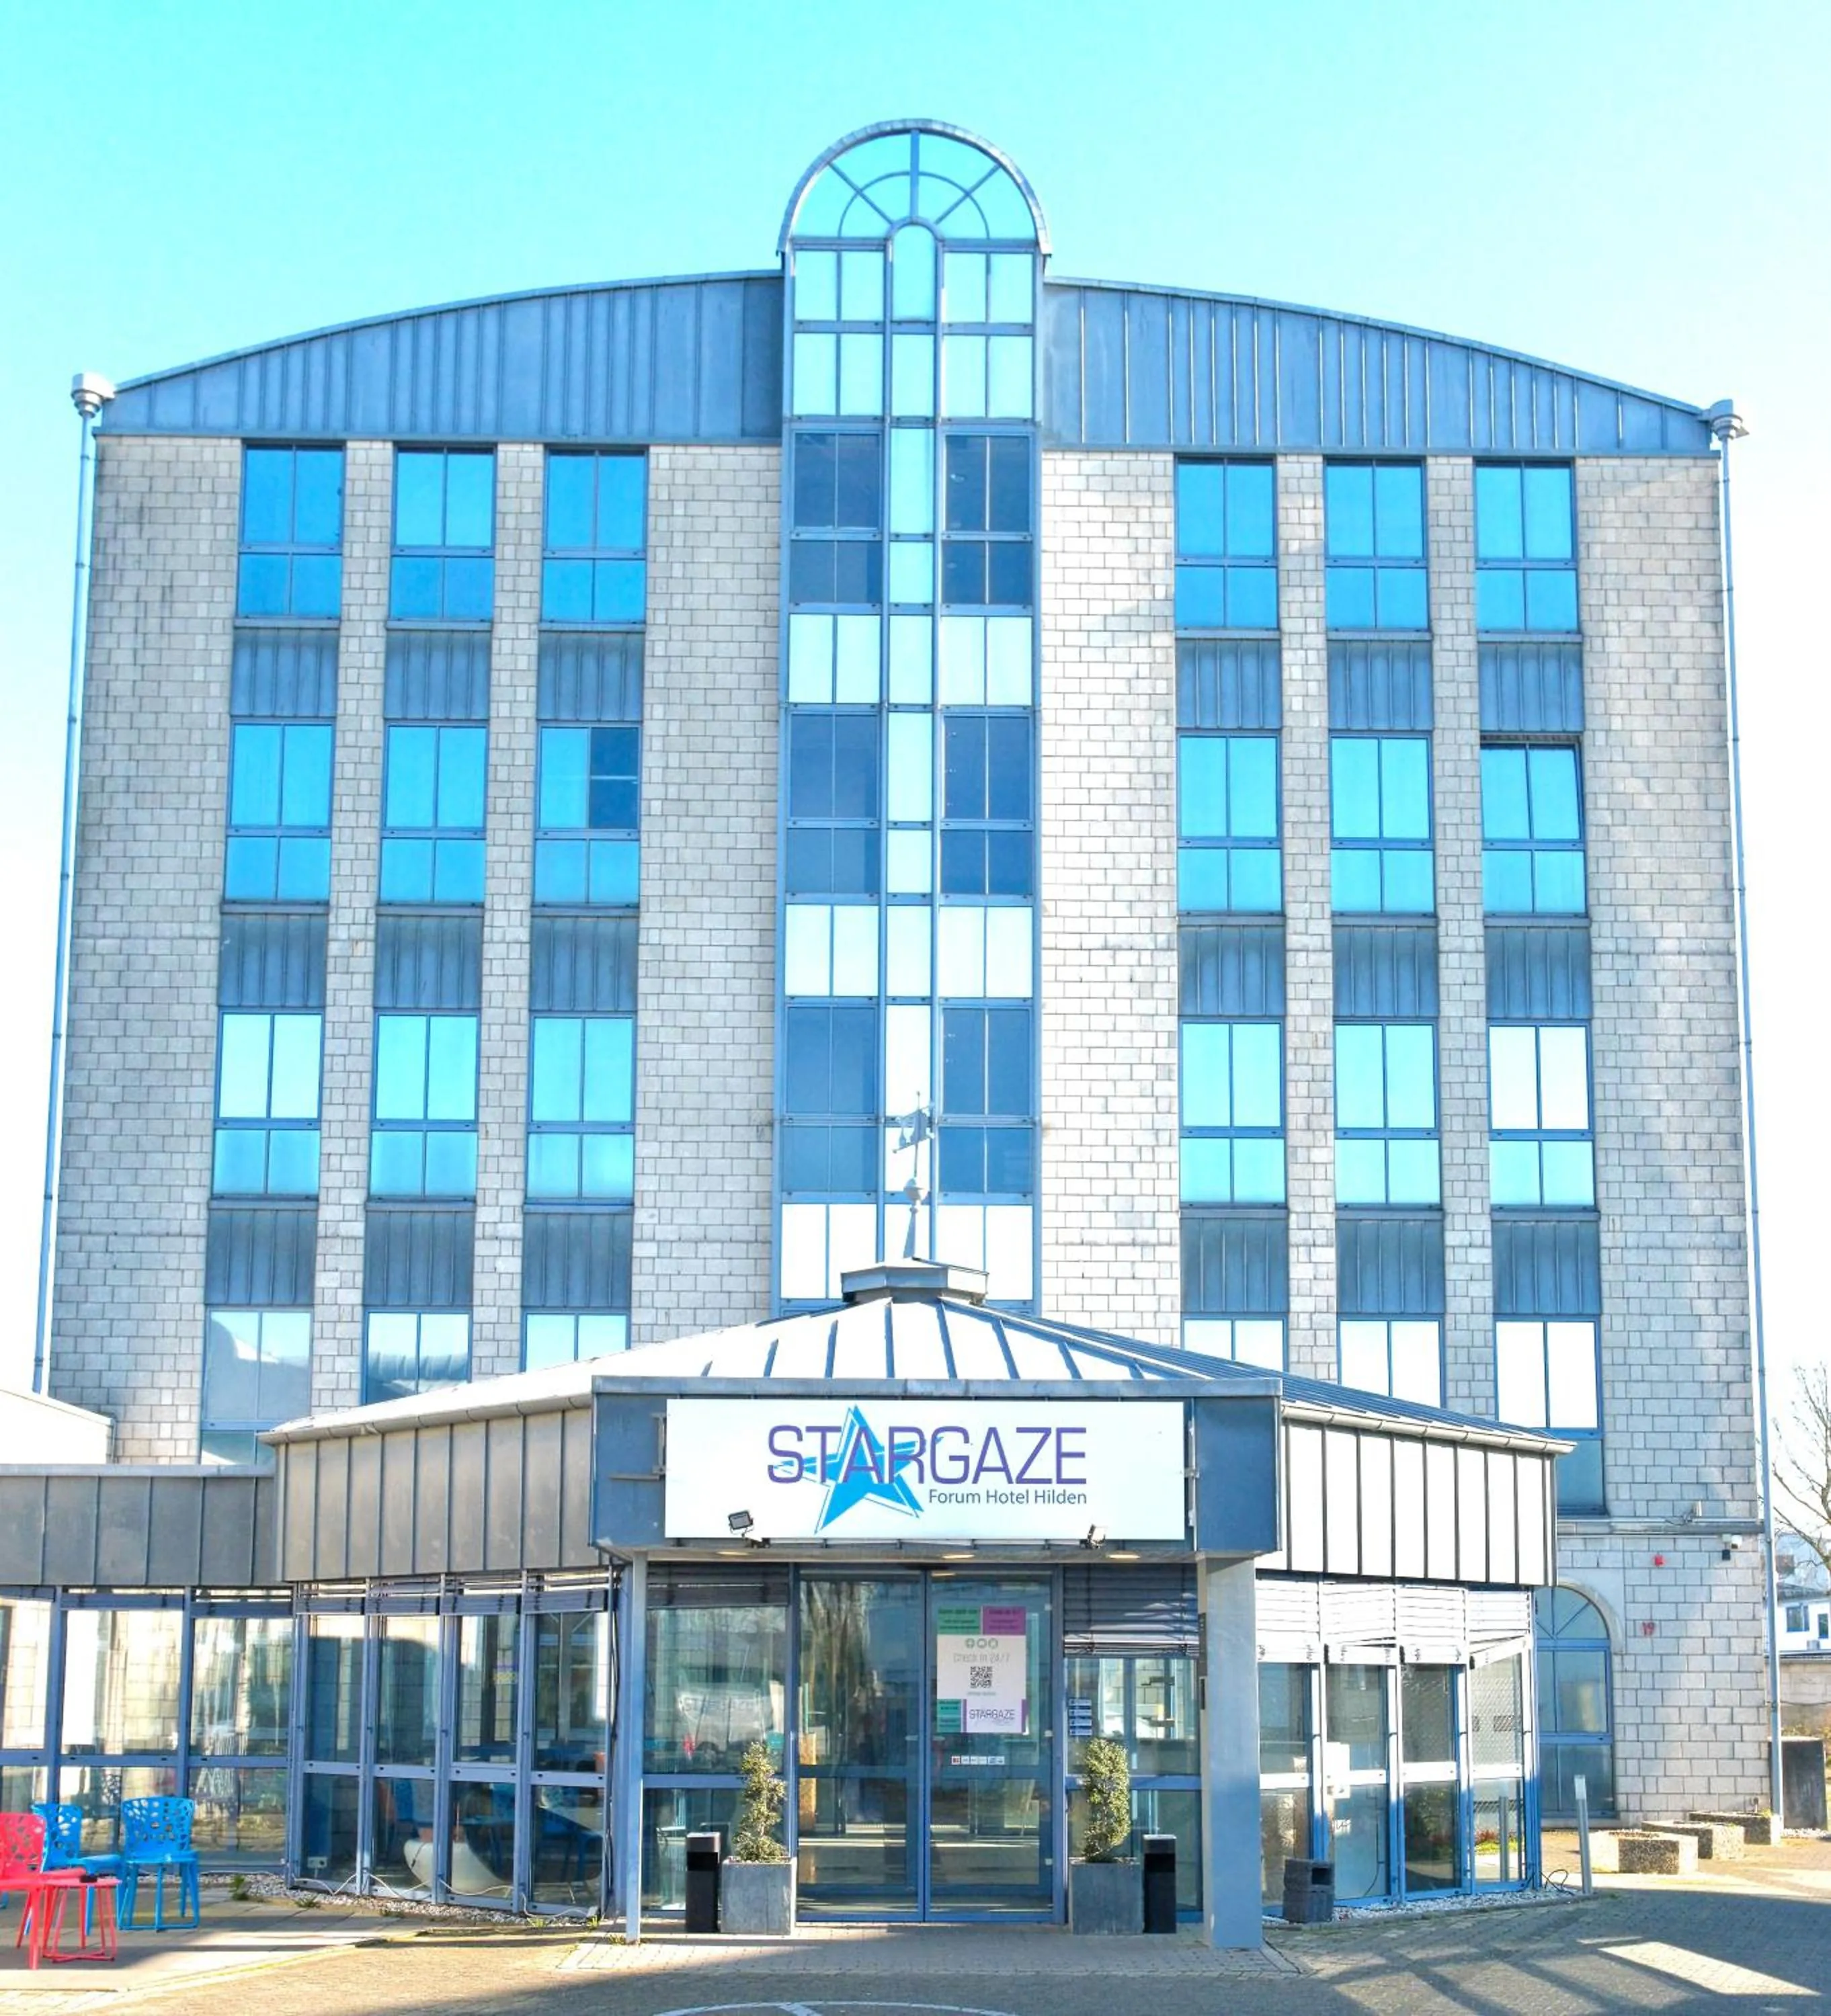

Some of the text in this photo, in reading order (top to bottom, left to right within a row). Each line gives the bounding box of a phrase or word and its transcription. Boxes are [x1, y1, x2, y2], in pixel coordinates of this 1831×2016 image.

[768, 1425, 1086, 1484] STARGAZE
[929, 1488, 1087, 1505] Forum Hotel Hilden
[1642, 1621, 1656, 1636] 19
[969, 1709, 1016, 1720] STARGAZE
